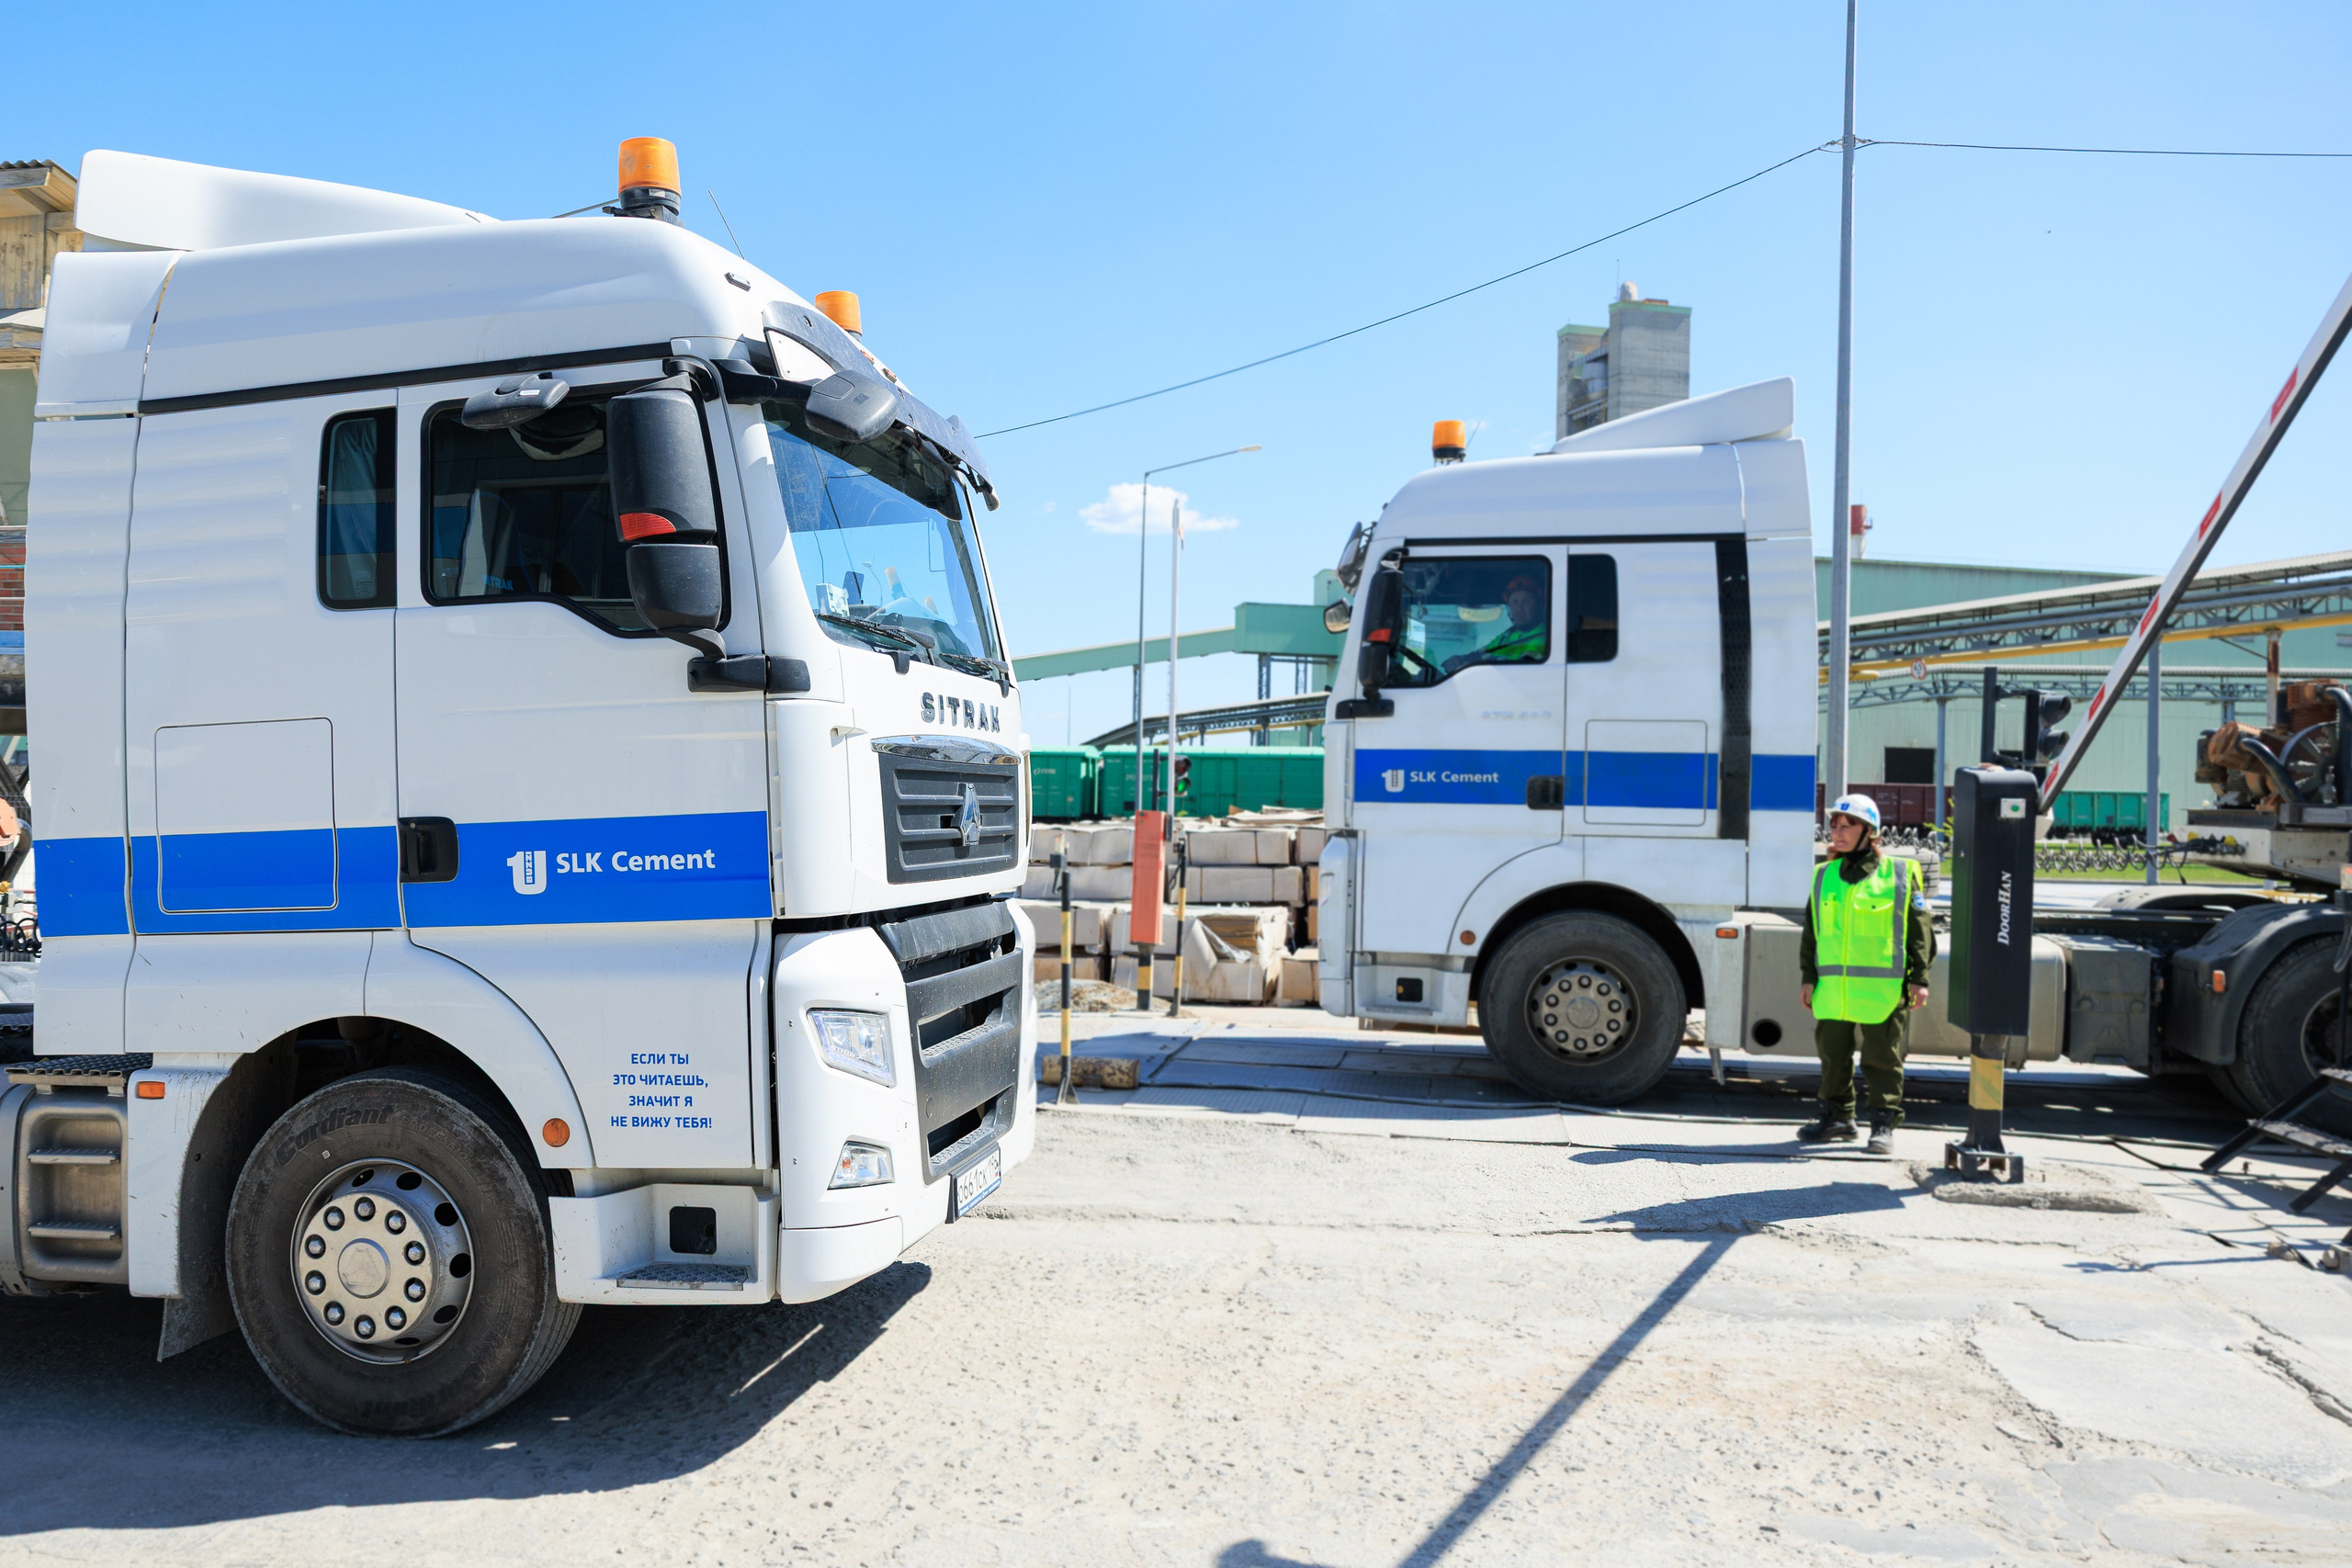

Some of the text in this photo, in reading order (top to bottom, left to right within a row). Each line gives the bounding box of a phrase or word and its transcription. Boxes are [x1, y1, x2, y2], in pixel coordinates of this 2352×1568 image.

[481, 574, 514, 591] SITRAK
[921, 692, 1001, 733] SITRAK
[1409, 772, 1436, 783] SLK
[1442, 772, 1498, 783] Cement
[556, 849, 716, 874] SLK Cement
[631, 1054, 689, 1065] ЕСЛИ ТЫ
[613, 1075, 708, 1088] ЭТО ЧИТАЕШЬ,
[628, 1096, 693, 1107] ЗНАЧИТ Я
[611, 1116, 712, 1128] НЕ ВИЖУ ТЕБЯ!
[276, 1103, 396, 1168] Cordiant
